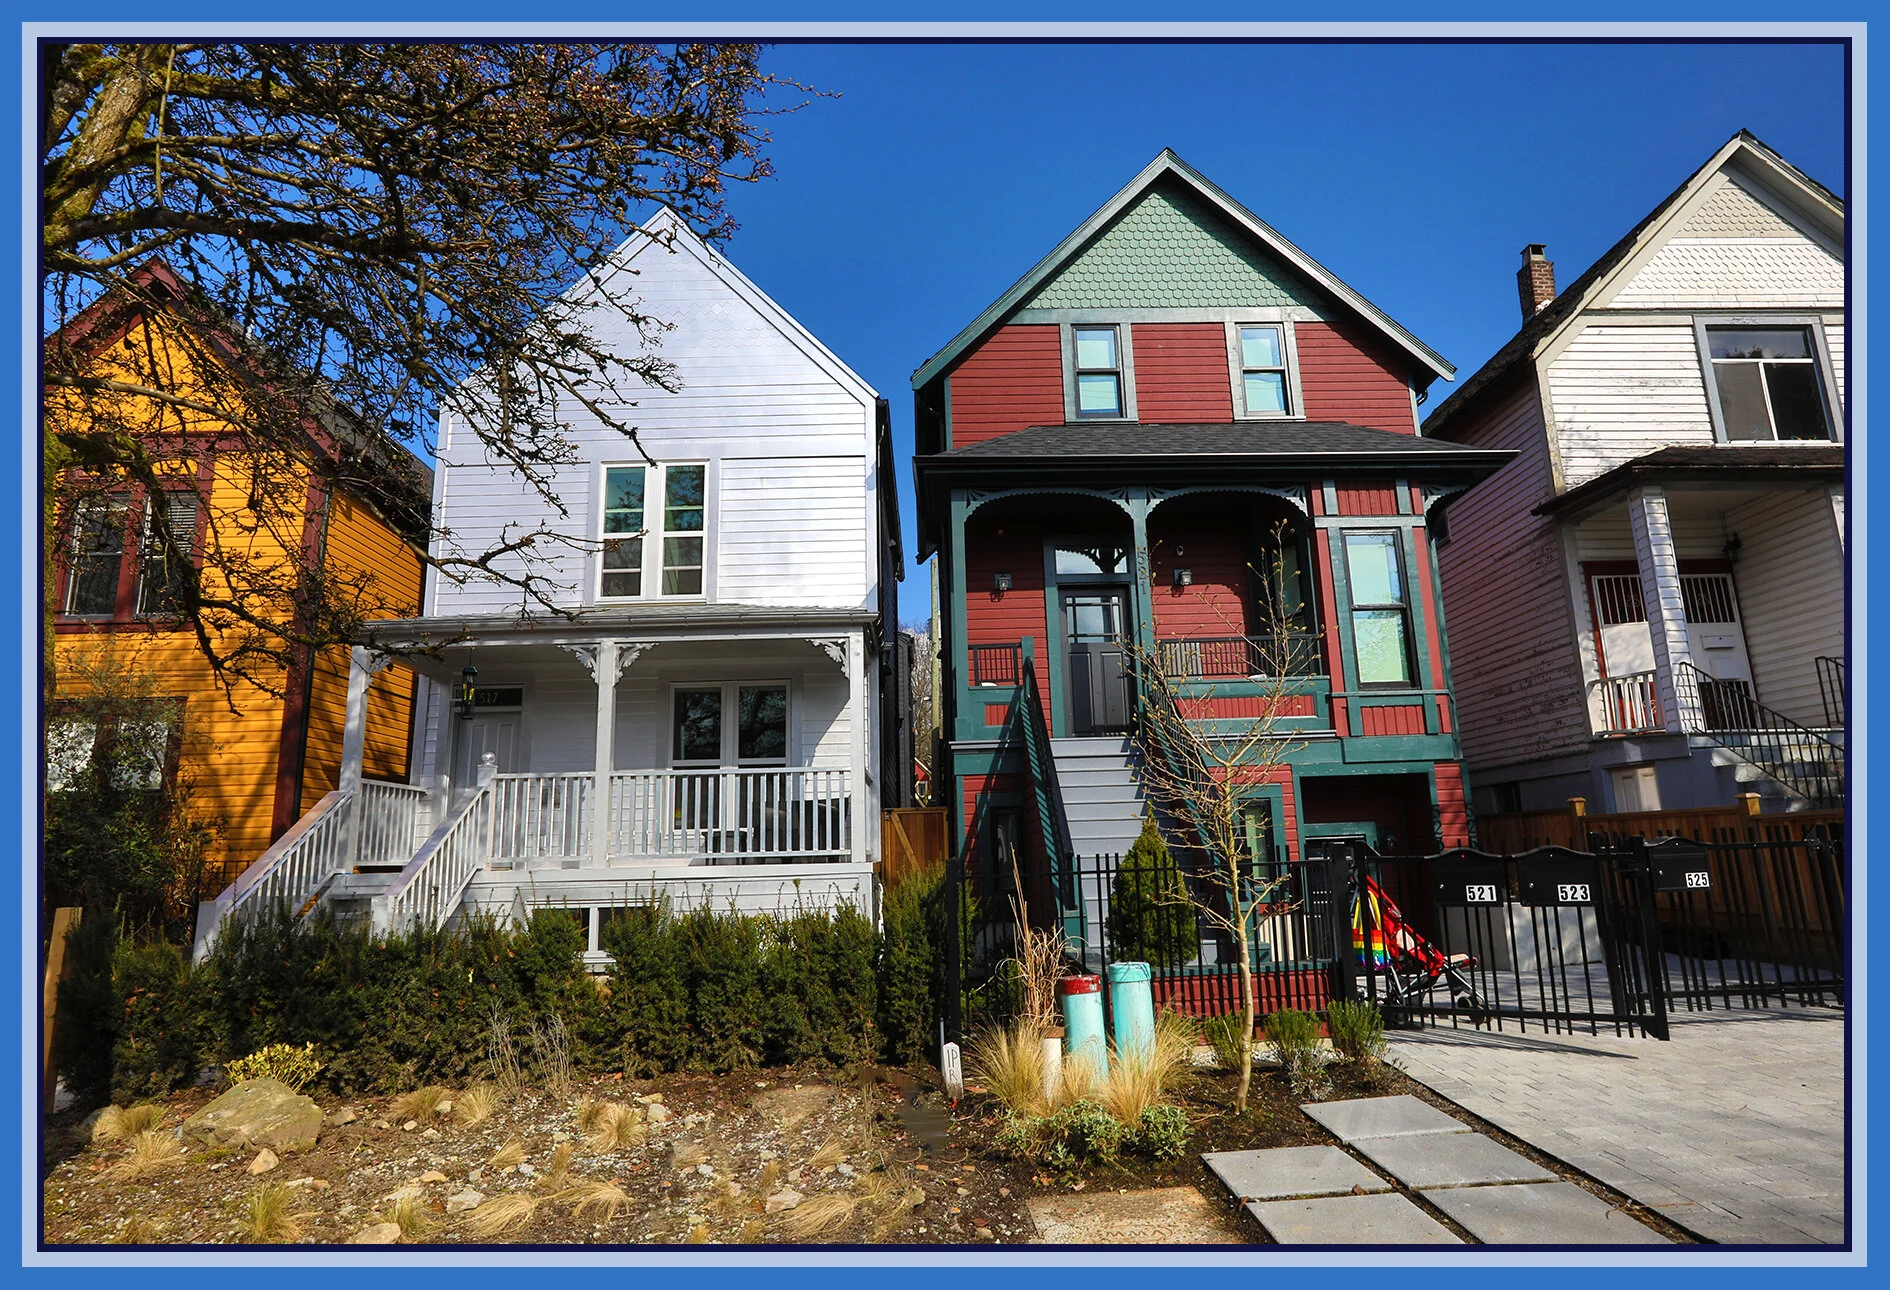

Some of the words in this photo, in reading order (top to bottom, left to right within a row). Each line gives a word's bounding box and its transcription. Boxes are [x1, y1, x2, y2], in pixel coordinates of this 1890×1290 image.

[1137, 551, 1147, 595] 521
[479, 692, 499, 704] 517
[1686, 873, 1709, 887] 525
[1467, 886, 1495, 901] 521
[1559, 886, 1589, 901] 523
[949, 1069, 958, 1081] R
